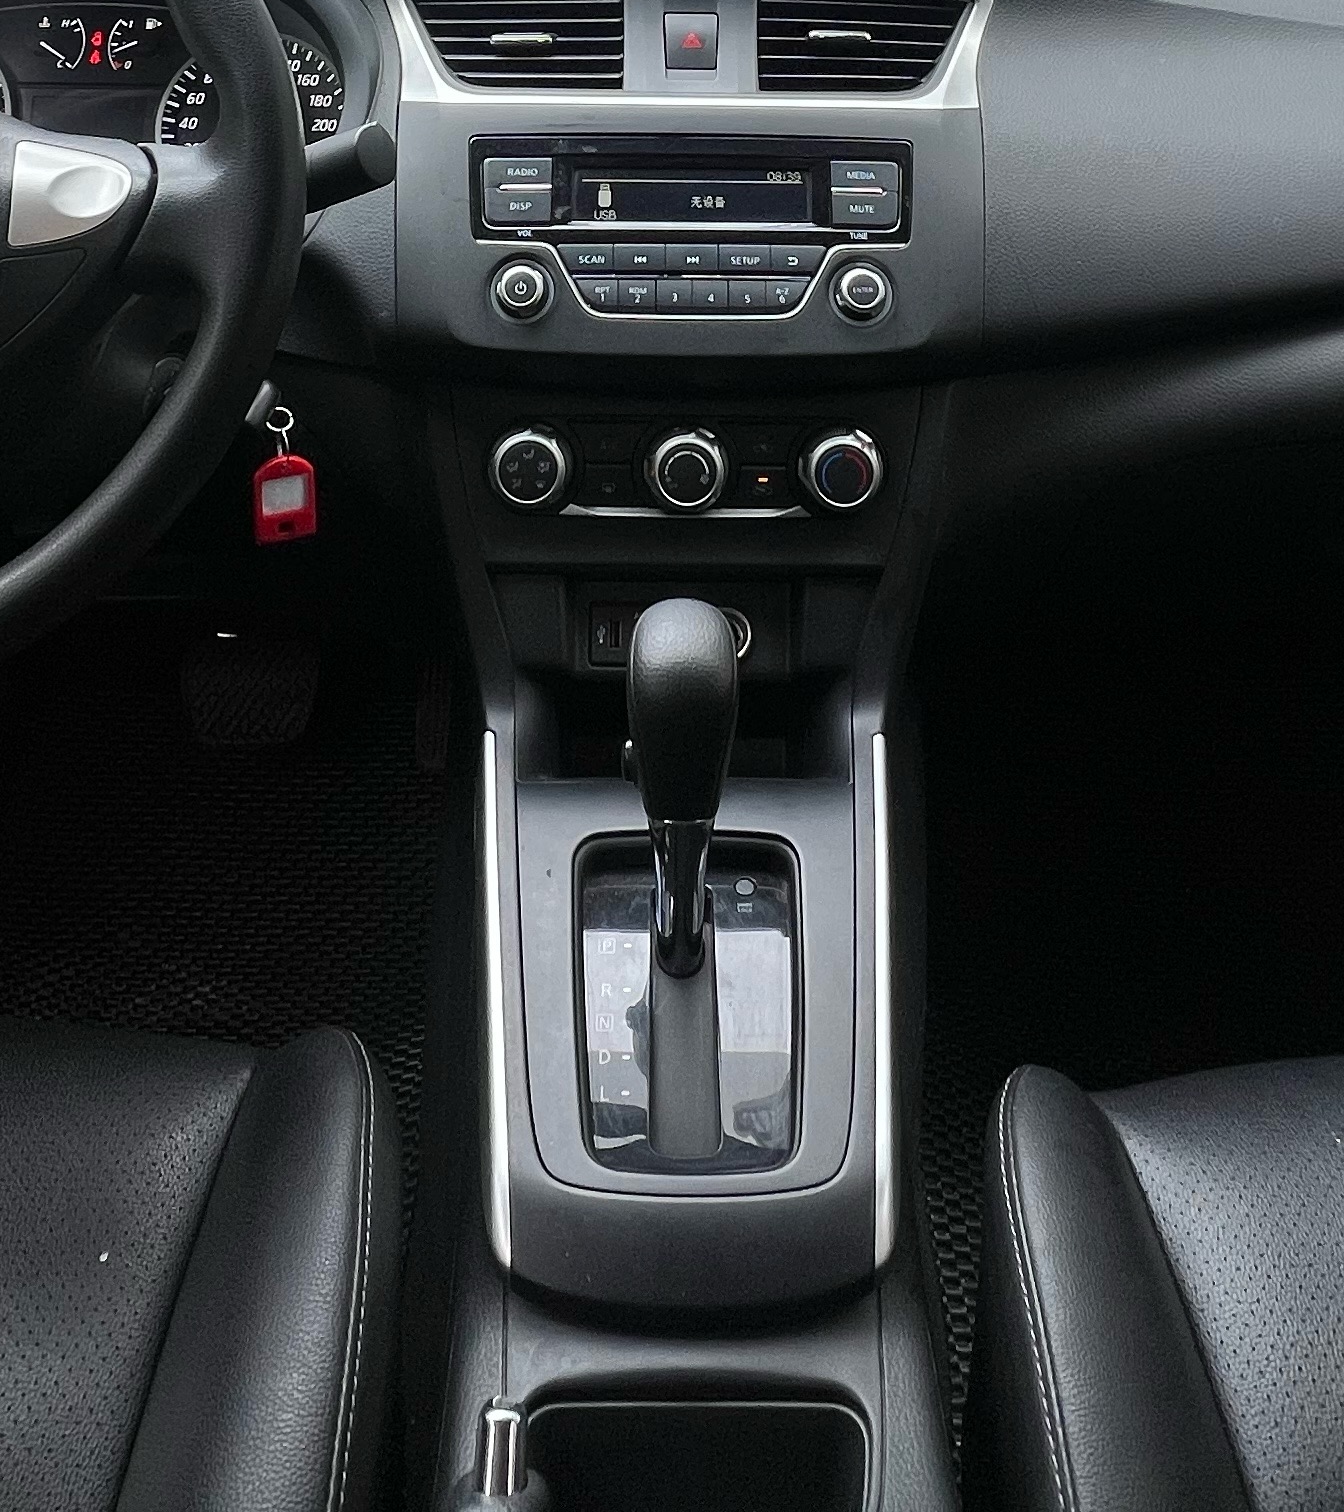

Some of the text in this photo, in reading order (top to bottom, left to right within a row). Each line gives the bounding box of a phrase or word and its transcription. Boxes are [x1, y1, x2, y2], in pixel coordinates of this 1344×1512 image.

[297, 74, 320, 86] 160
[187, 92, 205, 105] 60
[309, 94, 332, 107] 180
[179, 117, 198, 130] 40
[312, 119, 337, 132] 200
[507, 168, 539, 177] RADIO
[847, 171, 875, 180] MEDIA
[510, 202, 532, 211] DISP
[691, 196, 725, 208] 无设备
[850, 205, 874, 214] MUTE
[594, 210, 616, 220] USB
[578, 255, 605, 264] SCAN
[731, 256, 761, 265] SETUP
[600, 294, 605, 303] 1
[635, 294, 640, 303] 2
[672, 293, 677, 302] 3
[708, 294, 715, 303] 4
[745, 294, 750, 303] 5
[779, 295, 785, 304] 6
[600, 983, 612, 996] R
[599, 1016, 610, 1029] N
[598, 1050, 611, 1064] D
[600, 1086, 610, 1101] L
